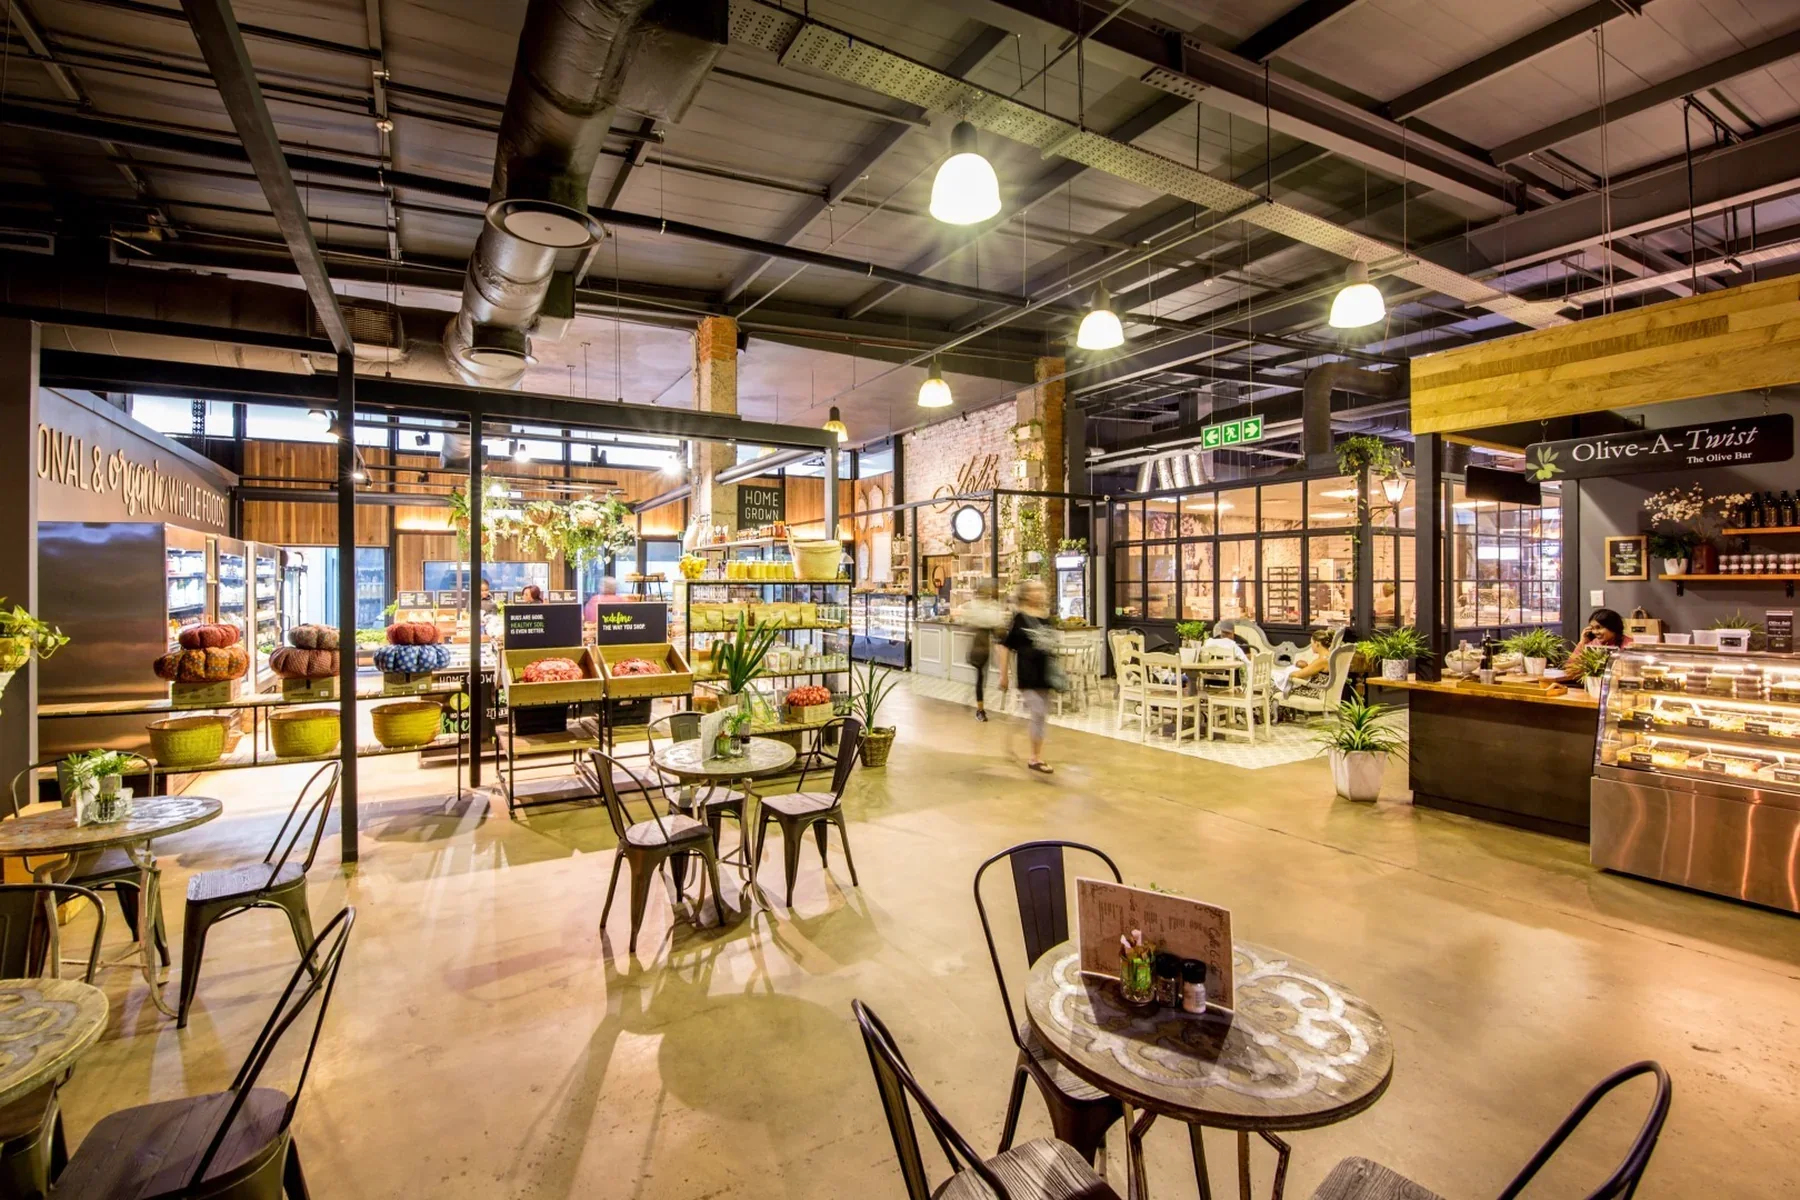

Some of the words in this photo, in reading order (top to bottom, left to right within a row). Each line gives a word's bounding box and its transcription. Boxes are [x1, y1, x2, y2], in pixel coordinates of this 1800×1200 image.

[1572, 426, 1759, 462] Olive-A-Twist
[1686, 456, 1705, 464] The
[1706, 453, 1732, 462] Olive
[1734, 451, 1753, 460] Bar
[91, 445, 105, 494] &
[107, 448, 168, 516] organic
[168, 475, 200, 520] WHOLE
[202, 489, 226, 528] FOODS
[744, 490, 779, 507] HOME
[744, 507, 779, 521] GROWN
[440, 675, 465, 685] HOME
